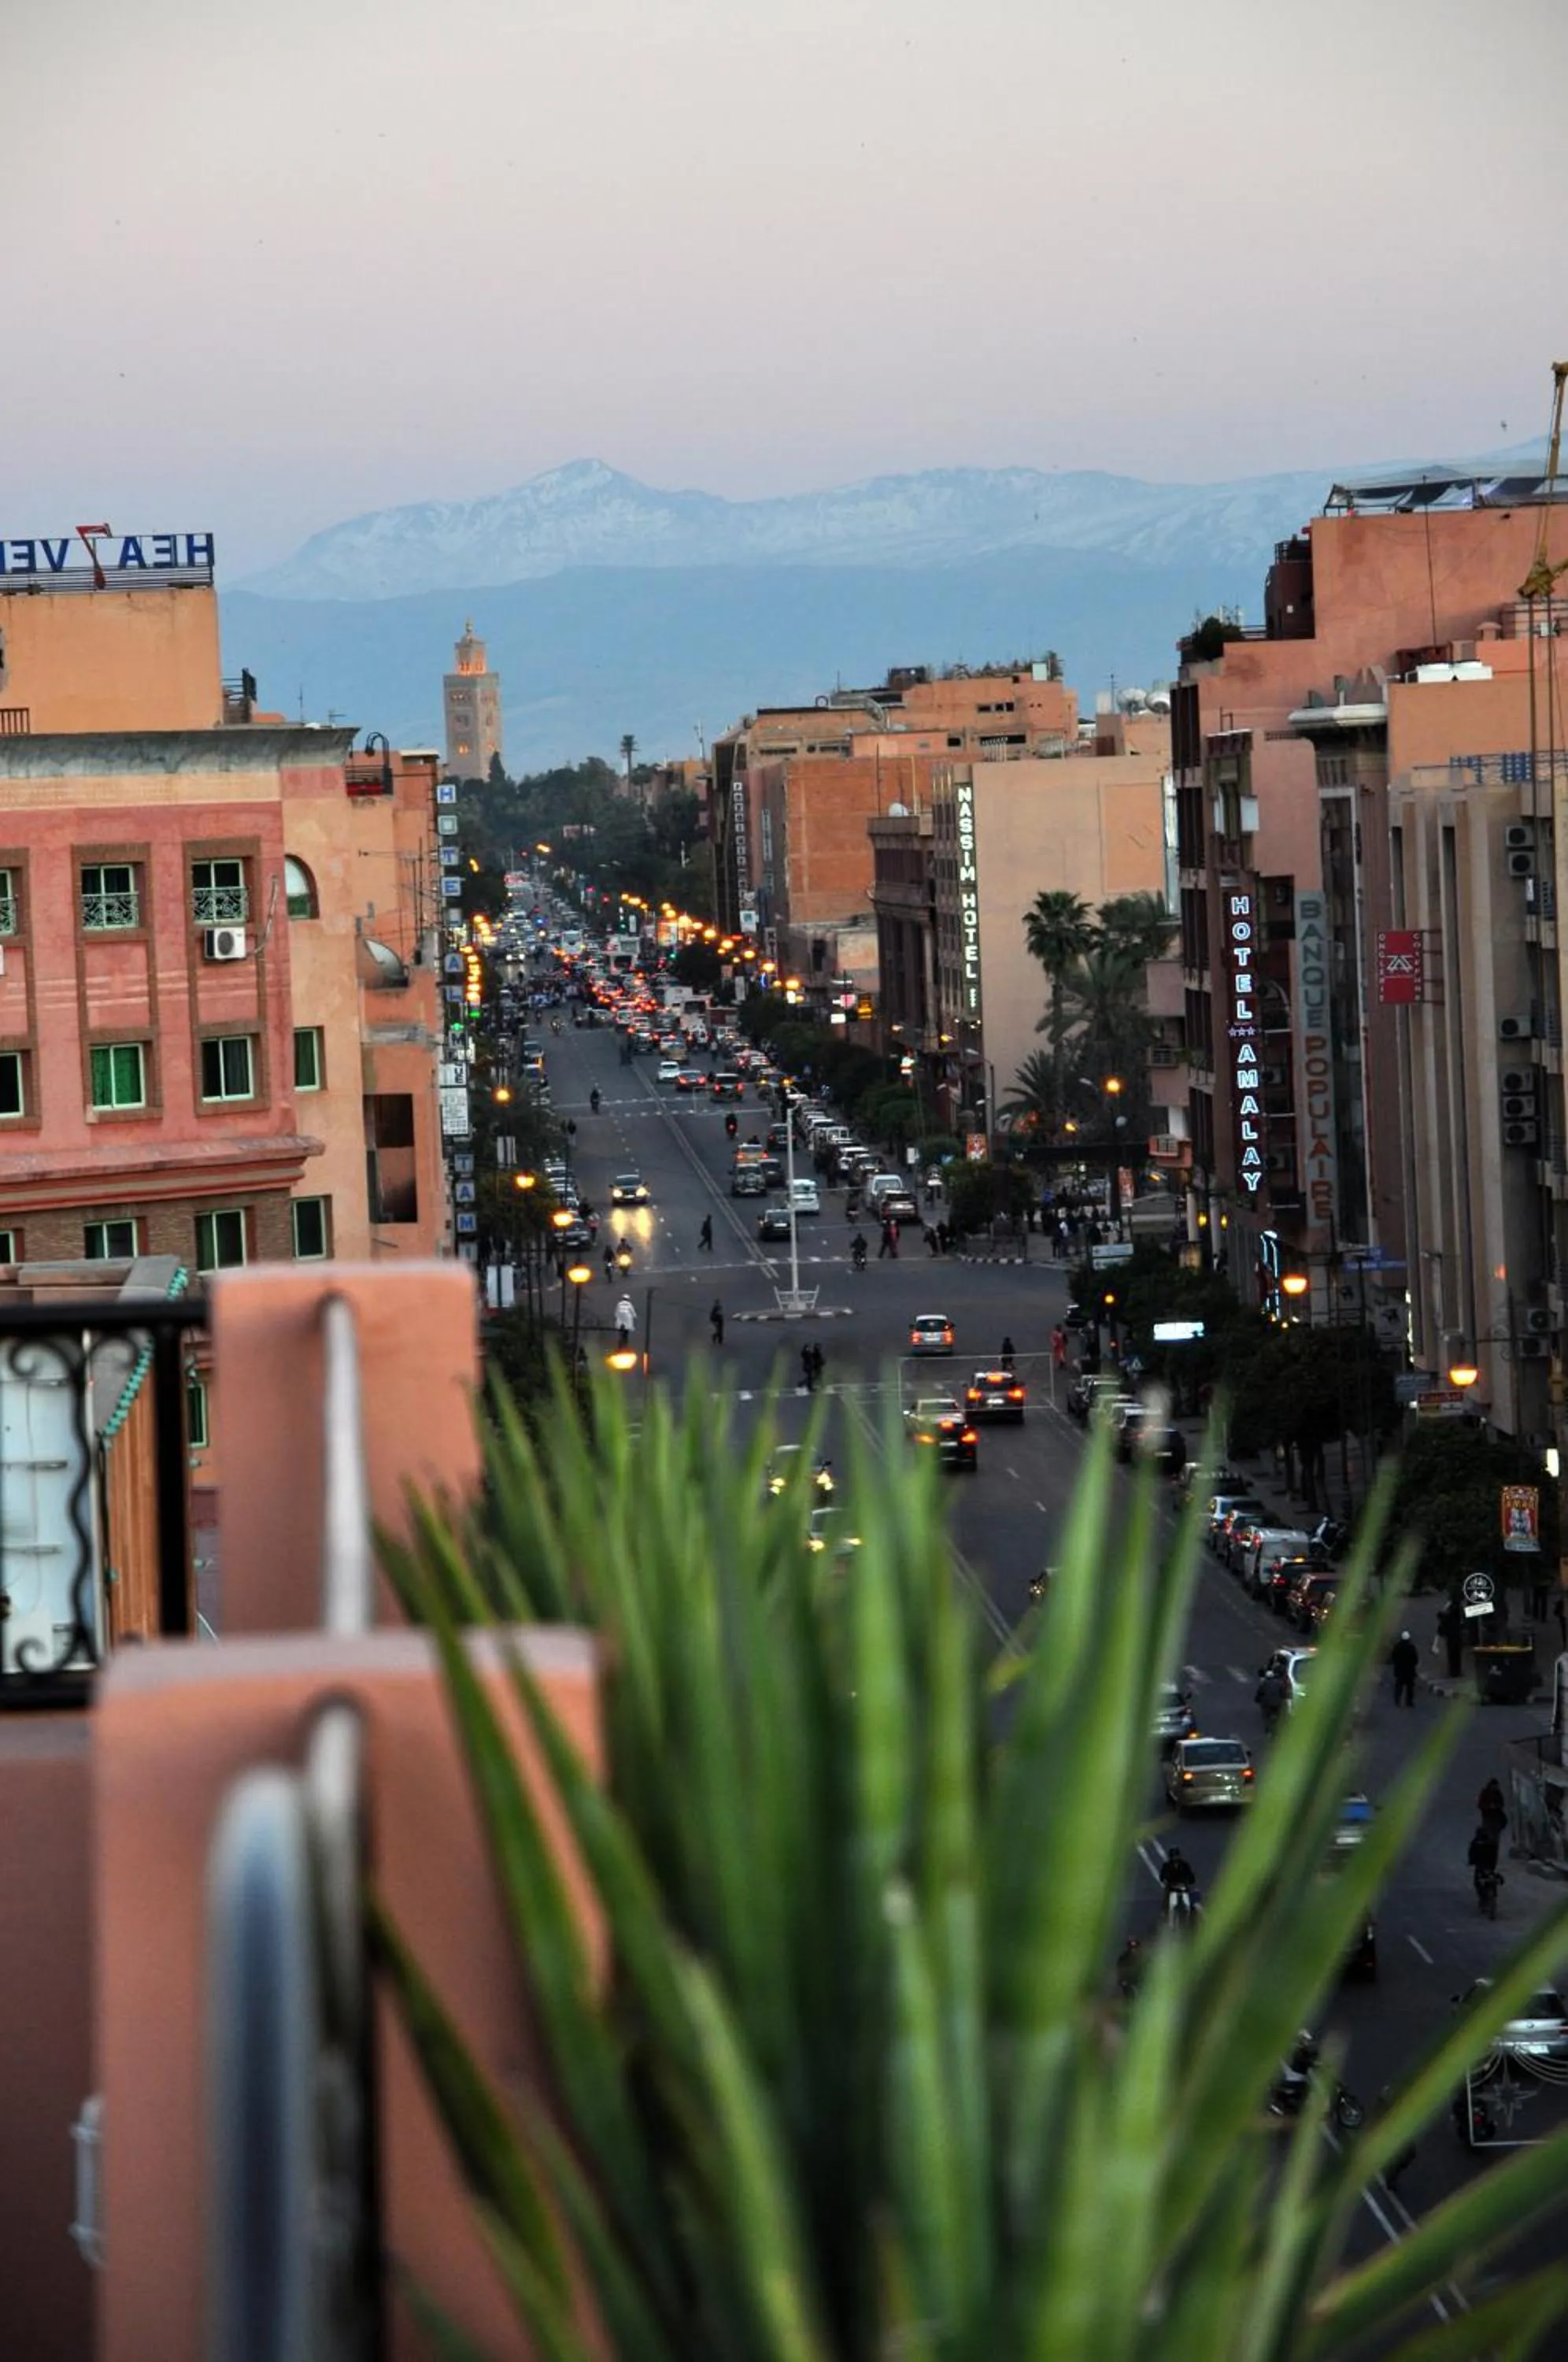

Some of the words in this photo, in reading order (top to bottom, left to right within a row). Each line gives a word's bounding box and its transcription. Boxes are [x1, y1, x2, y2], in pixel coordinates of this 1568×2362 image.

[438, 786, 461, 925] HOTEL
[957, 787, 975, 881] NASSIM
[962, 894, 978, 978] HOTEL
[1231, 896, 1252, 1020] HOTEL
[1300, 900, 1326, 1028] BANQUE
[1237, 1043, 1261, 1191] AMALAY
[1304, 1036, 1333, 1220] POPULAIRE
